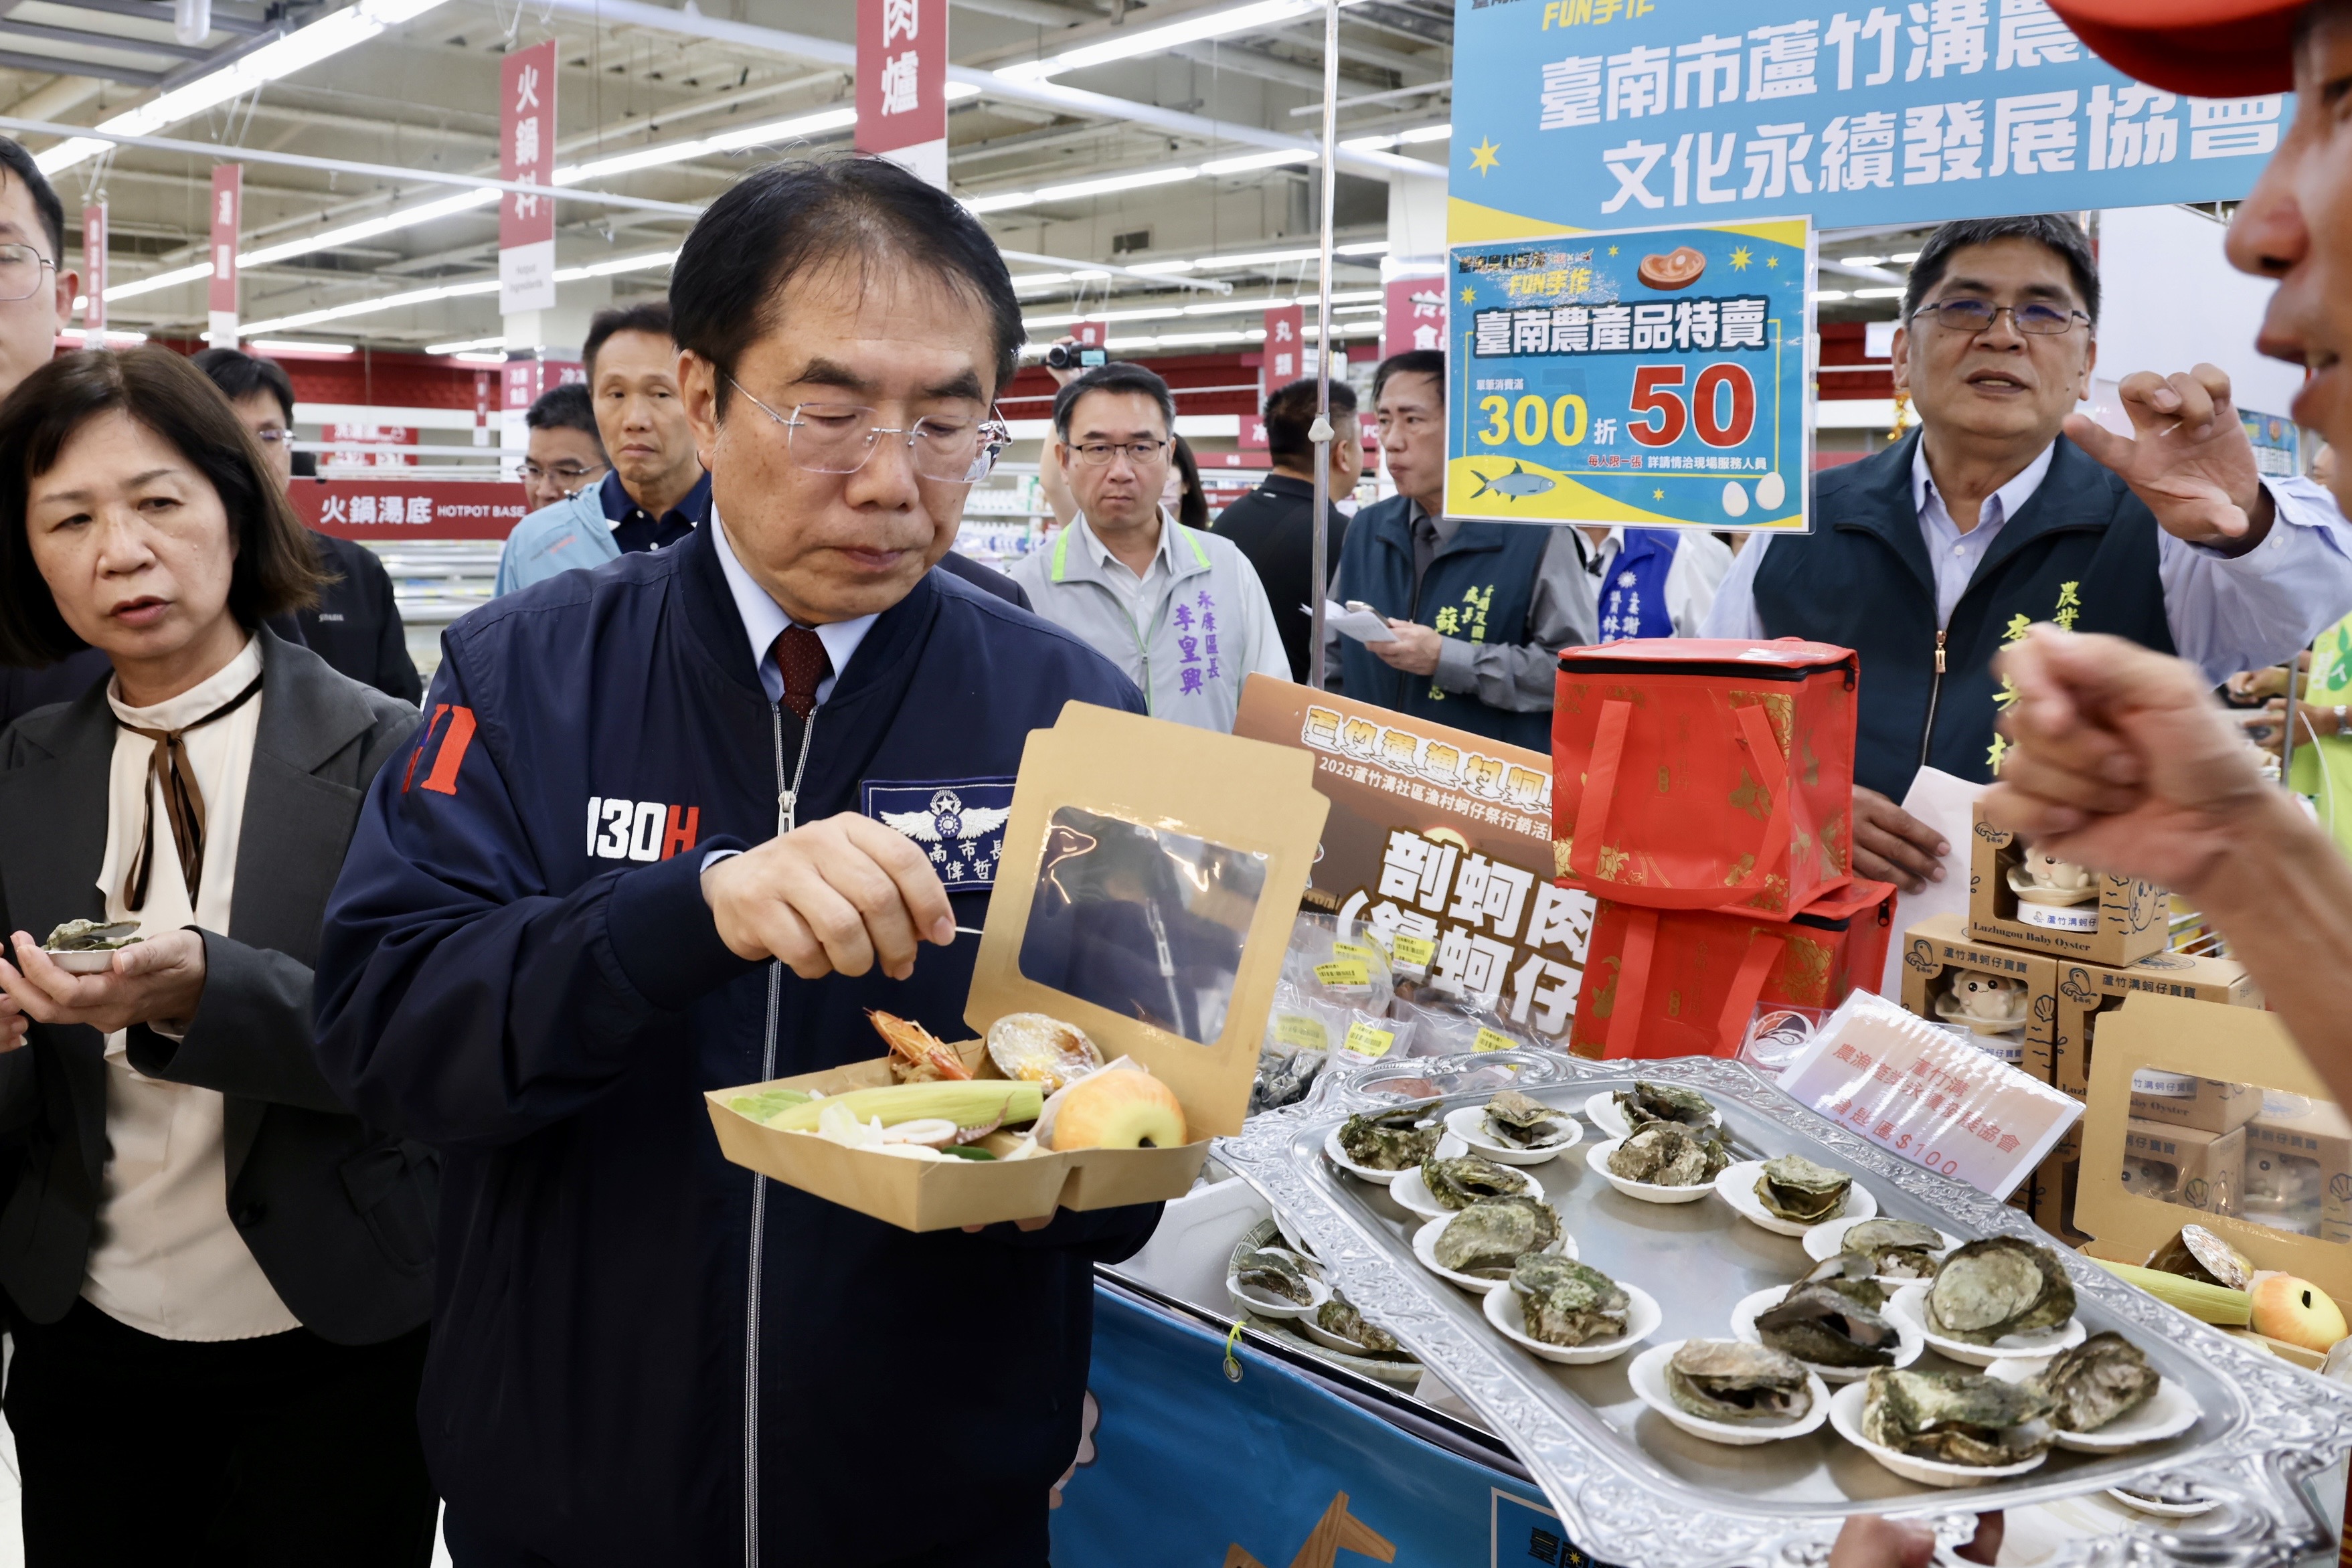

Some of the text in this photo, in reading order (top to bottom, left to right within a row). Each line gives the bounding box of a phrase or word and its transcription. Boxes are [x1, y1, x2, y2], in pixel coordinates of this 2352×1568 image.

[1539, 0, 2098, 130] 臺南市蘆竹溝農
[515, 64, 539, 220] 火鍋料
[1601, 82, 2282, 214] 文化永續發展協會
[1475, 299, 1766, 355] 臺南農產品特賣
[1478, 362, 1758, 448] 300 折 50
[1588, 454, 1643, 468] 每人限一張
[320, 495, 527, 525] 火鍋湯底 HOTPOT BASE
[1173, 604, 1203, 697] 李皇興
[1197, 590, 1220, 679] 永康區長
[1304, 708, 1551, 813] 蘆竹溝漁村蚵
[1319, 757, 1552, 842] 2025蘆竹溝社區漁村蚵仔祭行銷活
[1378, 831, 1598, 964] 剖蚵肉
[1974, 922, 2091, 952] Luzhugou Baby Oyster
[1943, 947, 2028, 974] 蘆竹溝蚵仔寶寶
[2102, 974, 2197, 1000] 蘆竹溝蚵仔寶寶
[1909, 1057, 1971, 1098] 蘆竹溝
